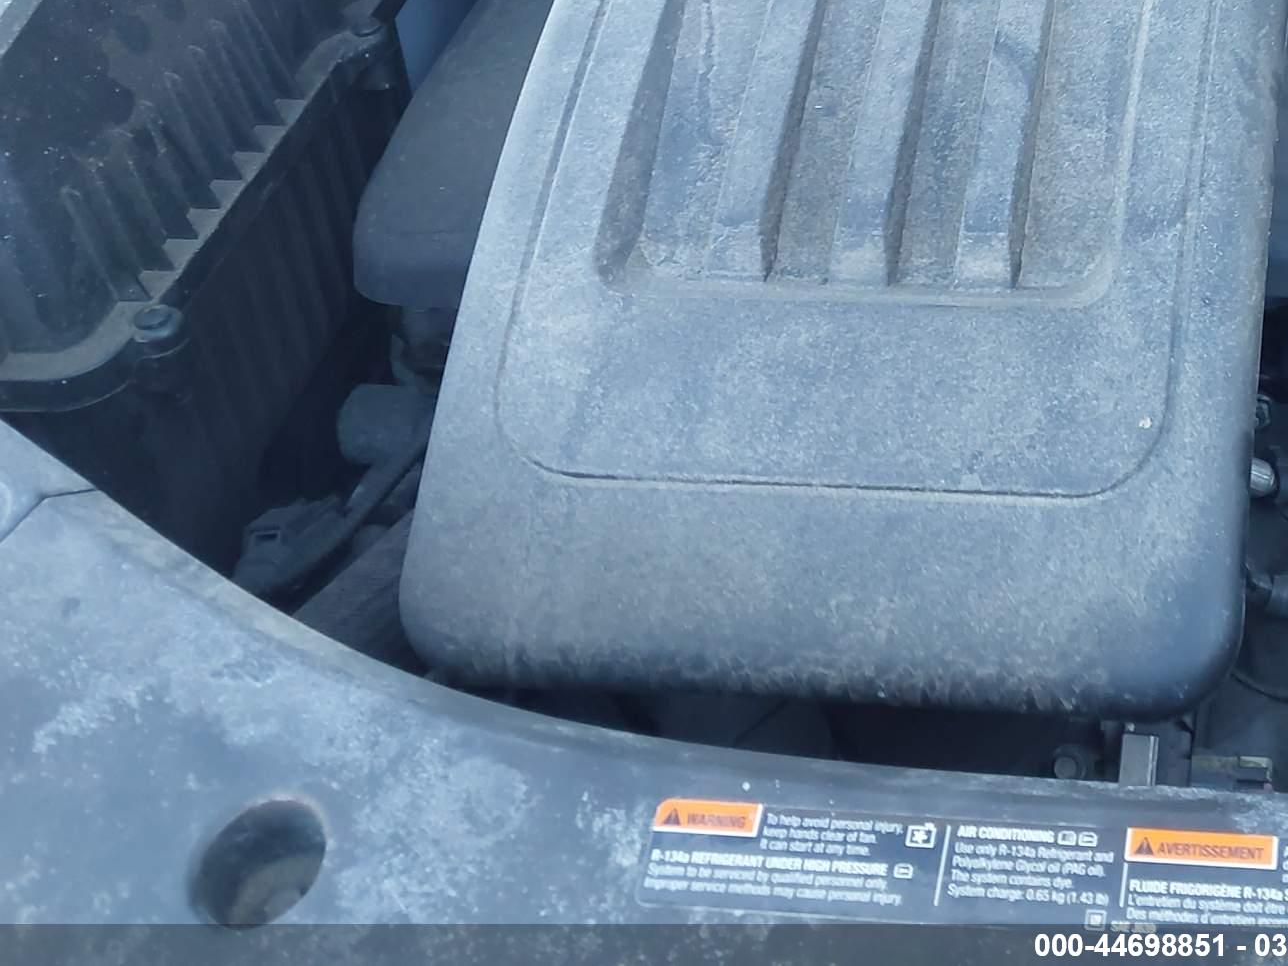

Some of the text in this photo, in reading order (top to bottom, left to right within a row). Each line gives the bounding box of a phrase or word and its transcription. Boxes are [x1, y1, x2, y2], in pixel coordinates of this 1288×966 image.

[687, 813, 746, 828] WARNING
[766, 813, 778, 825] To
[779, 814, 801, 827] help
[801, 816, 830, 828] avoid
[830, 818, 872, 832] personal
[762, 825, 787, 839] keep
[788, 827, 818, 840] hands
[820, 829, 845, 841] clear
[846, 831, 858, 842] of
[956, 824, 1054, 842] AIR CONDITIONING
[768, 839, 788, 850] can
[788, 840, 812, 852] start
[812, 842, 824, 853] at
[824, 843, 844, 856] any
[845, 844, 870, 856] time.
[954, 841, 1114, 863] Use only R-134a Refrigerant and
[1156, 840, 1264, 860] AVERTISSEMENT
[650, 847, 888, 876] R-134a REFRIGERANT UNDER HIGH PRESSURE
[1014, 858, 1046, 874] Glycol
[1047, 861, 1060, 873] oil
[1060, 861, 1086, 875] (PAG
[648, 861, 684, 877] System
[686, 865, 698, 877] to
[698, 866, 712, 878] be
[712, 867, 756, 881] serviced
[756, 870, 769, 884] by
[770, 871, 814, 886] qualified
[814, 873, 864, 889] personnel
[950, 869, 1072, 890] The system contains dye.
[690, 880, 727, 894] service
[727, 882, 771, 897] methods
[772, 886, 794, 899] may
[796, 887, 826, 899] cause
[827, 889, 872, 904] personal
[947, 882, 985, 899] System
[986, 885, 1024, 901] charge:
[1025, 887, 1050, 901] 0.65
[1050, 889, 1065, 904] kg
[1066, 890, 1094, 906] (1.43
[1128, 879, 1168, 894] FLUIDE
[1168, 879, 1242, 898] FRIGORIGÈNE
[1242, 886, 1284, 900] R-134a
[1127, 893, 1180, 908] L'entretien
[1182, 897, 1196, 909] du
[1197, 897, 1241, 914] système
[1242, 900, 1263, 913] doit
[1264, 901, 1285, 914] être
[1126, 905, 1146, 920] Des
[1148, 908, 1198, 923] méthodes
